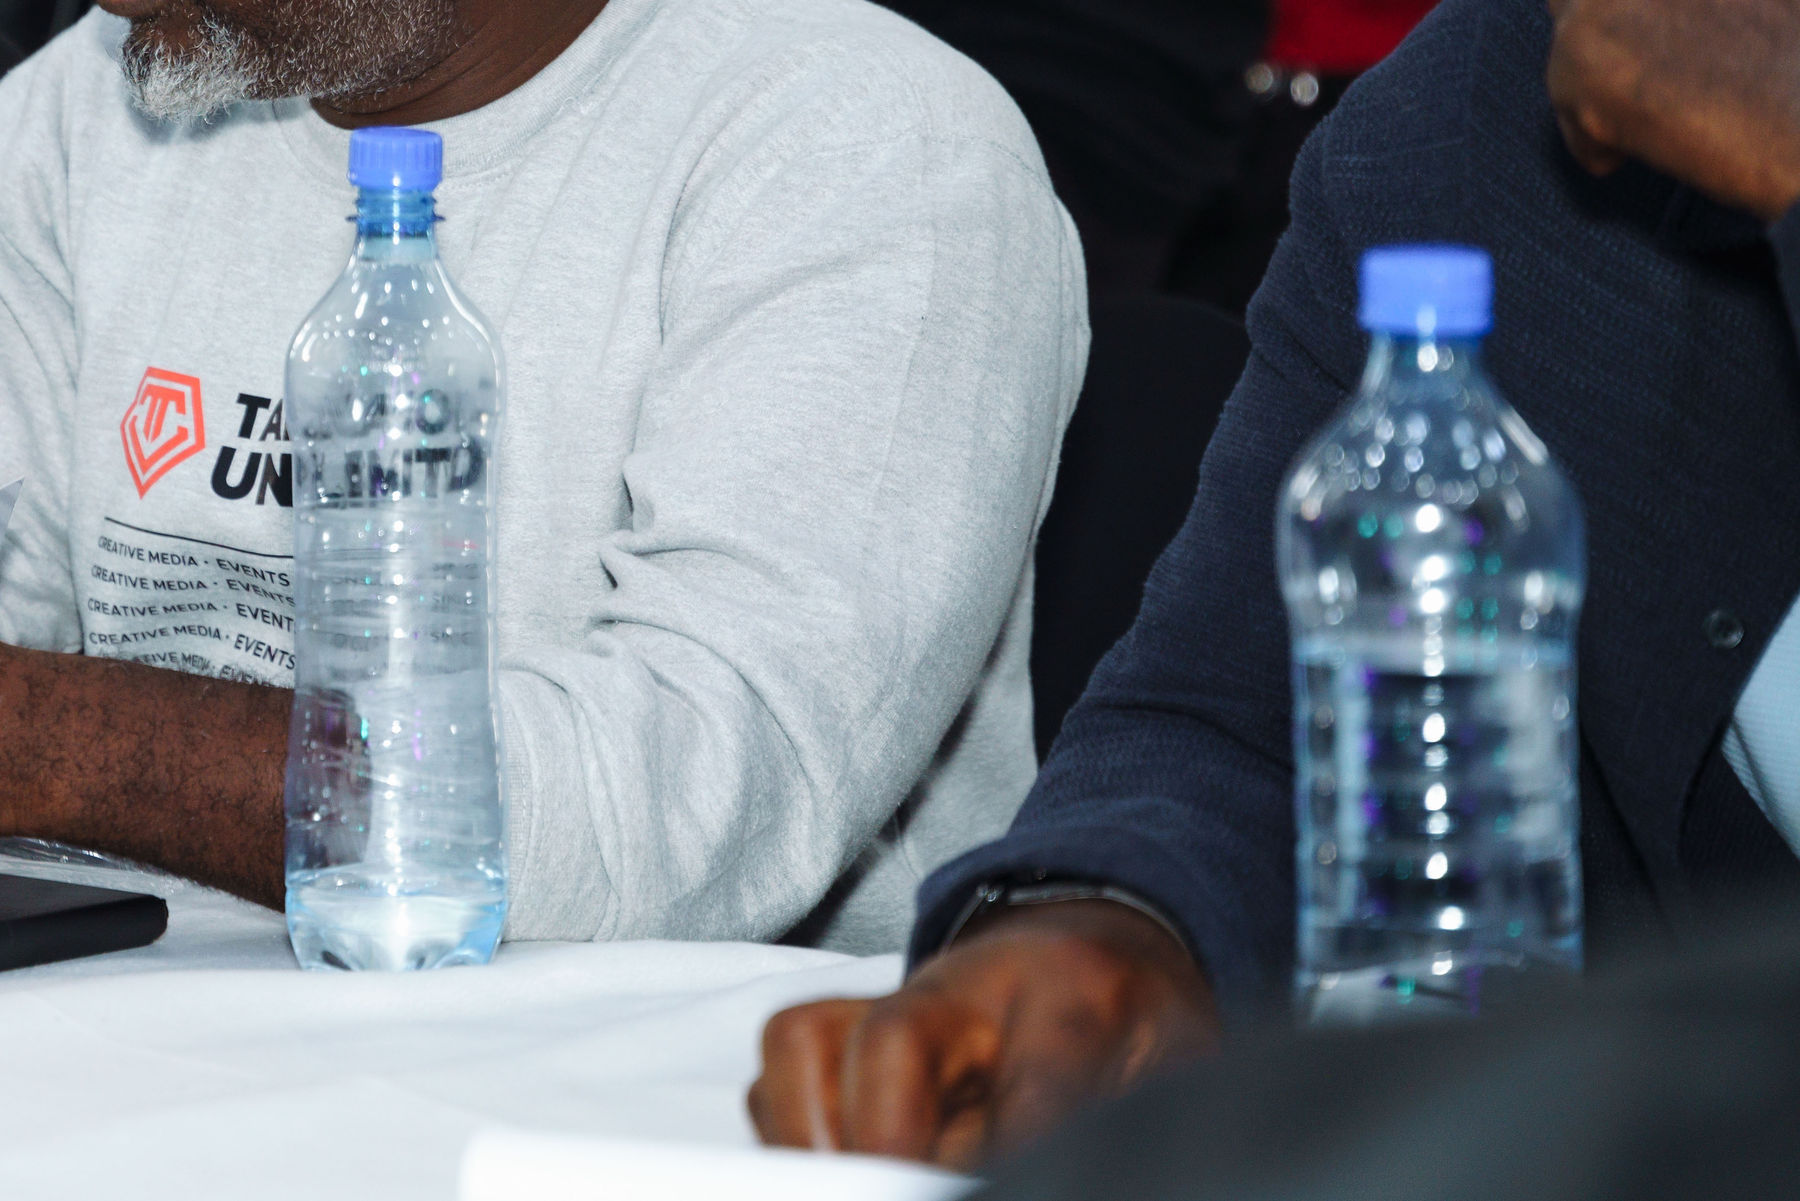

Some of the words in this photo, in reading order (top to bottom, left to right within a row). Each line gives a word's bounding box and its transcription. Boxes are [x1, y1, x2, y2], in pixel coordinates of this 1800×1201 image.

[98, 535, 145, 562] CREATIVE
[148, 550, 199, 567] MEDIA
[216, 558, 291, 587] EVENTS
[90, 564, 150, 590] CREATIVE
[153, 580, 208, 591] MEDIA
[226, 578, 296, 608] EVENTS
[87, 597, 160, 617] CREATIVE
[163, 602, 218, 614] MEDIA
[236, 603, 296, 633] EVENT
[88, 625, 169, 645] CREATIVE
[173, 624, 222, 641] MEDIA
[233, 633, 296, 670] EVENTS
